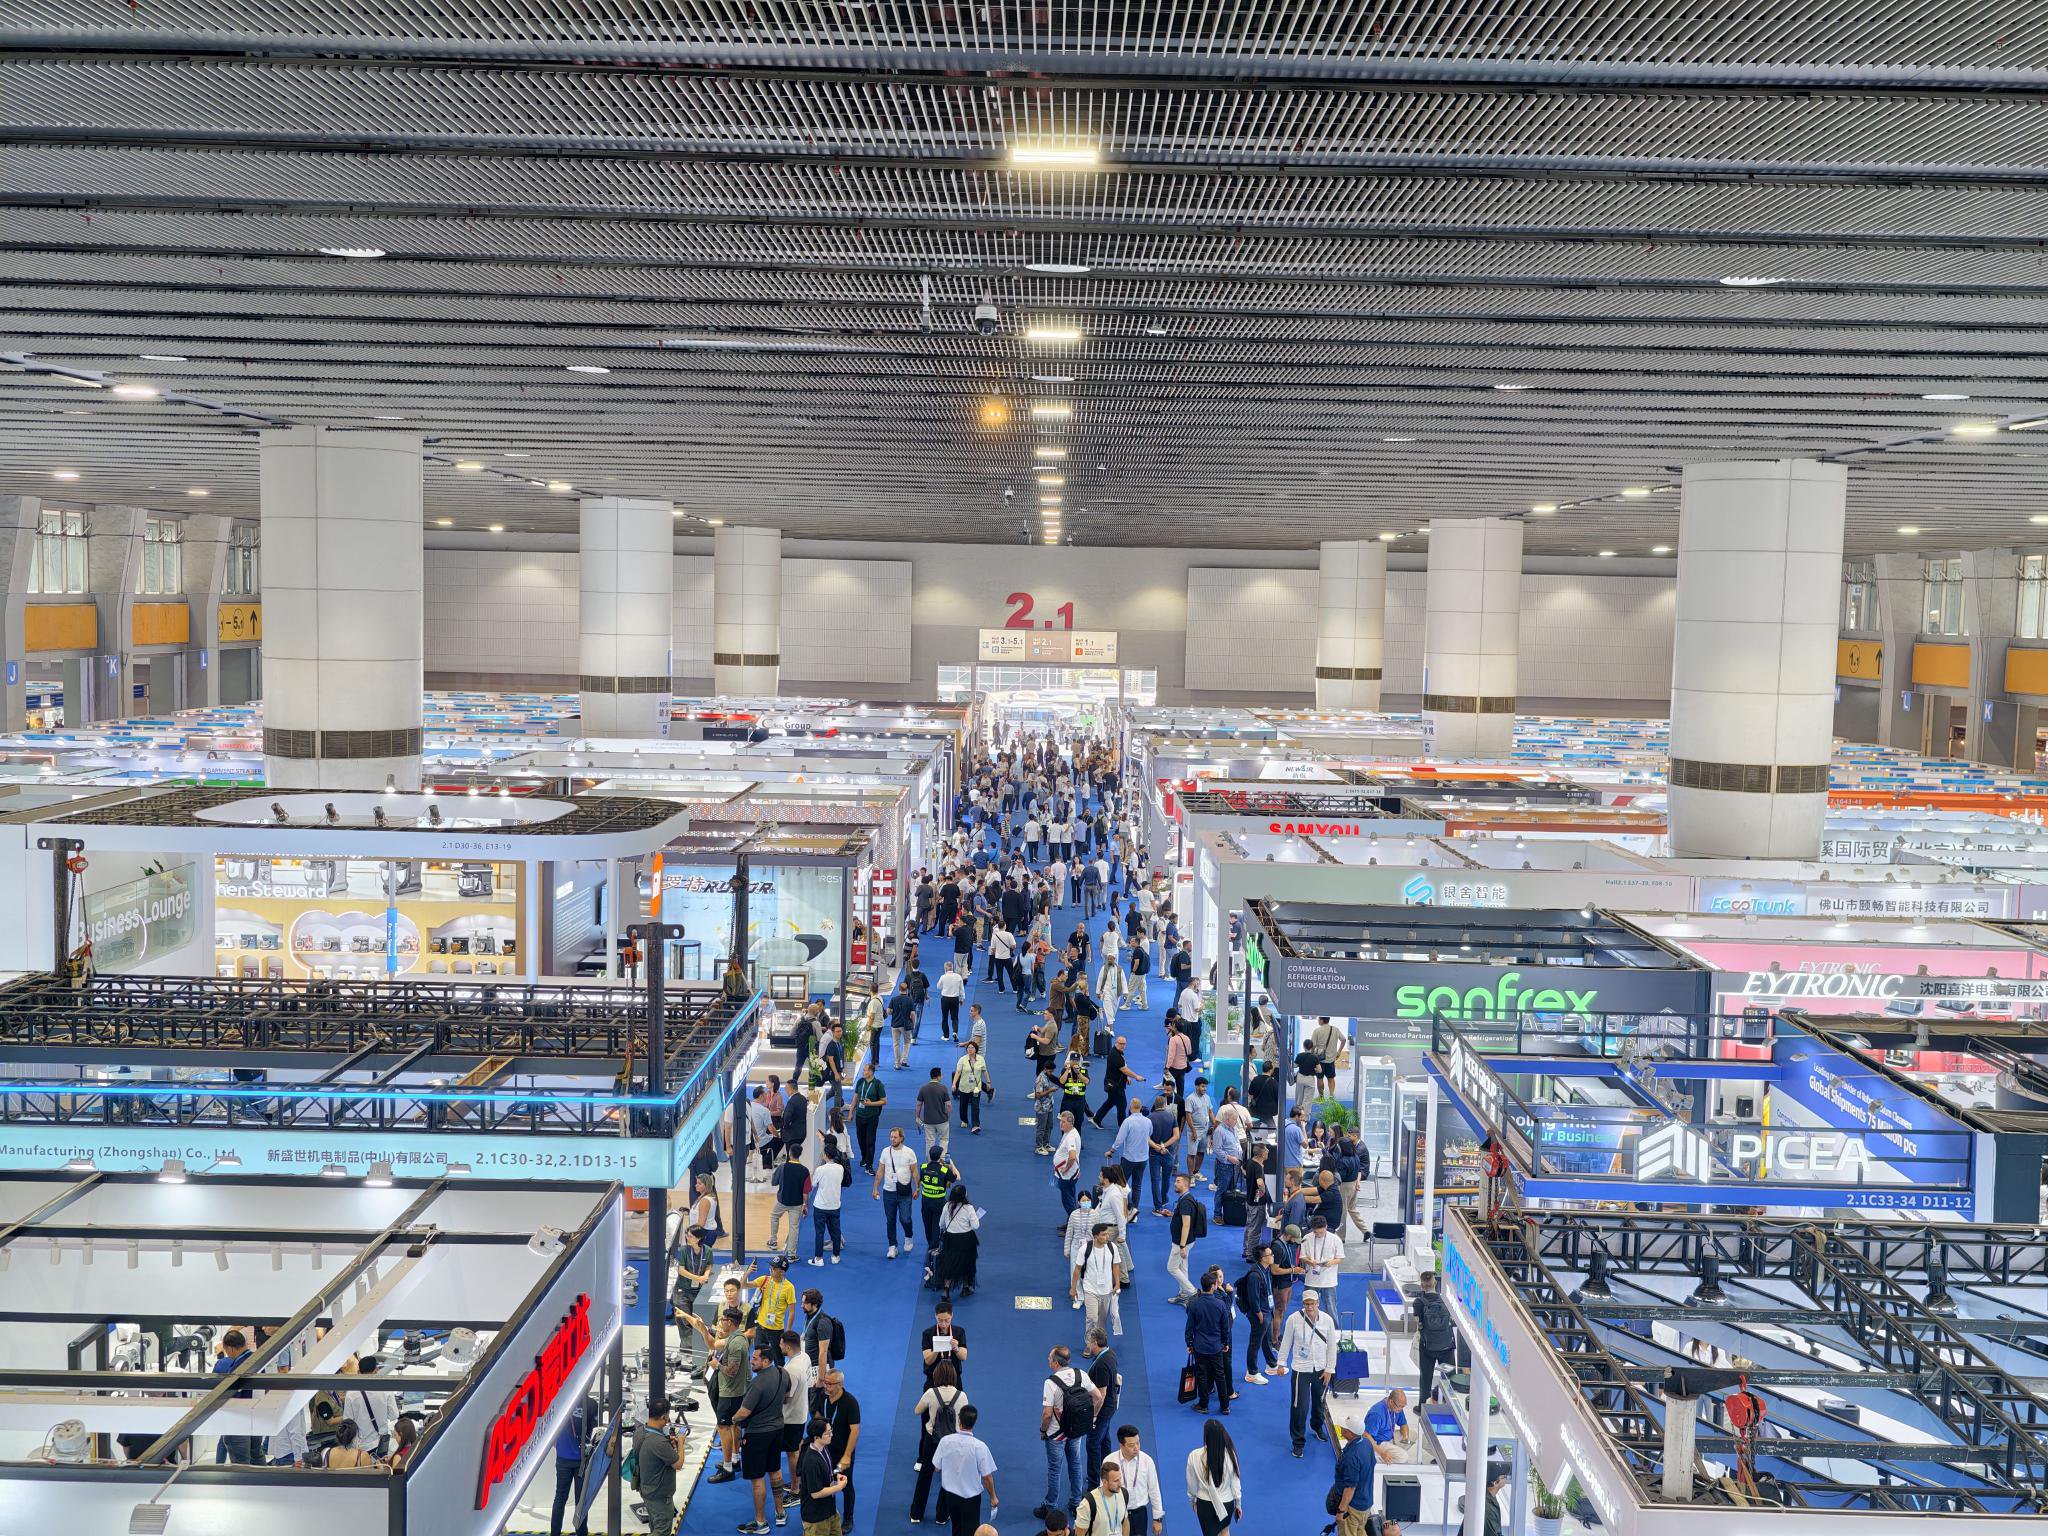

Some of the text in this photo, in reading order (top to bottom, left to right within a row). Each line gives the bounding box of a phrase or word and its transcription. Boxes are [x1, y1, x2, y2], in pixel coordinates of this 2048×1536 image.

[1005, 592, 1074, 629] 2.1
[109, 658, 118, 674] K
[252, 881, 328, 898] Steward
[1444, 886, 1505, 900] 银舍智能
[143, 891, 191, 926] Lounge
[1287, 965, 1339, 974] COMMERCIAL
[1287, 973, 1347, 982] REFRIGERATION
[1286, 981, 1370, 992] OEM/ODM SOLUTIONS
[1742, 972, 1904, 998] EYTRONIC
[1395, 972, 1599, 1022] sanfrex
[1382, 1031, 1406, 1039] Trusted
[1809, 1074, 1831, 1101] Global
[1830, 1087, 1867, 1124] Shipments
[1904, 1135, 1918, 1157] pcs
[98, 1145, 182, 1160] (Zhongshan)
[185, 1147, 211, 1160] Co.,
[267, 1148, 449, 1166] 新盛世机电制品(中山)有限公司
[476, 1152, 638, 1169] 2.1C30-32,2.1D13-15
[1732, 1134, 1871, 1172] PICEA
[1847, 1194, 1972, 1209] 2.1C33-34 D11-12
[480, 1369, 539, 1511] ASD
